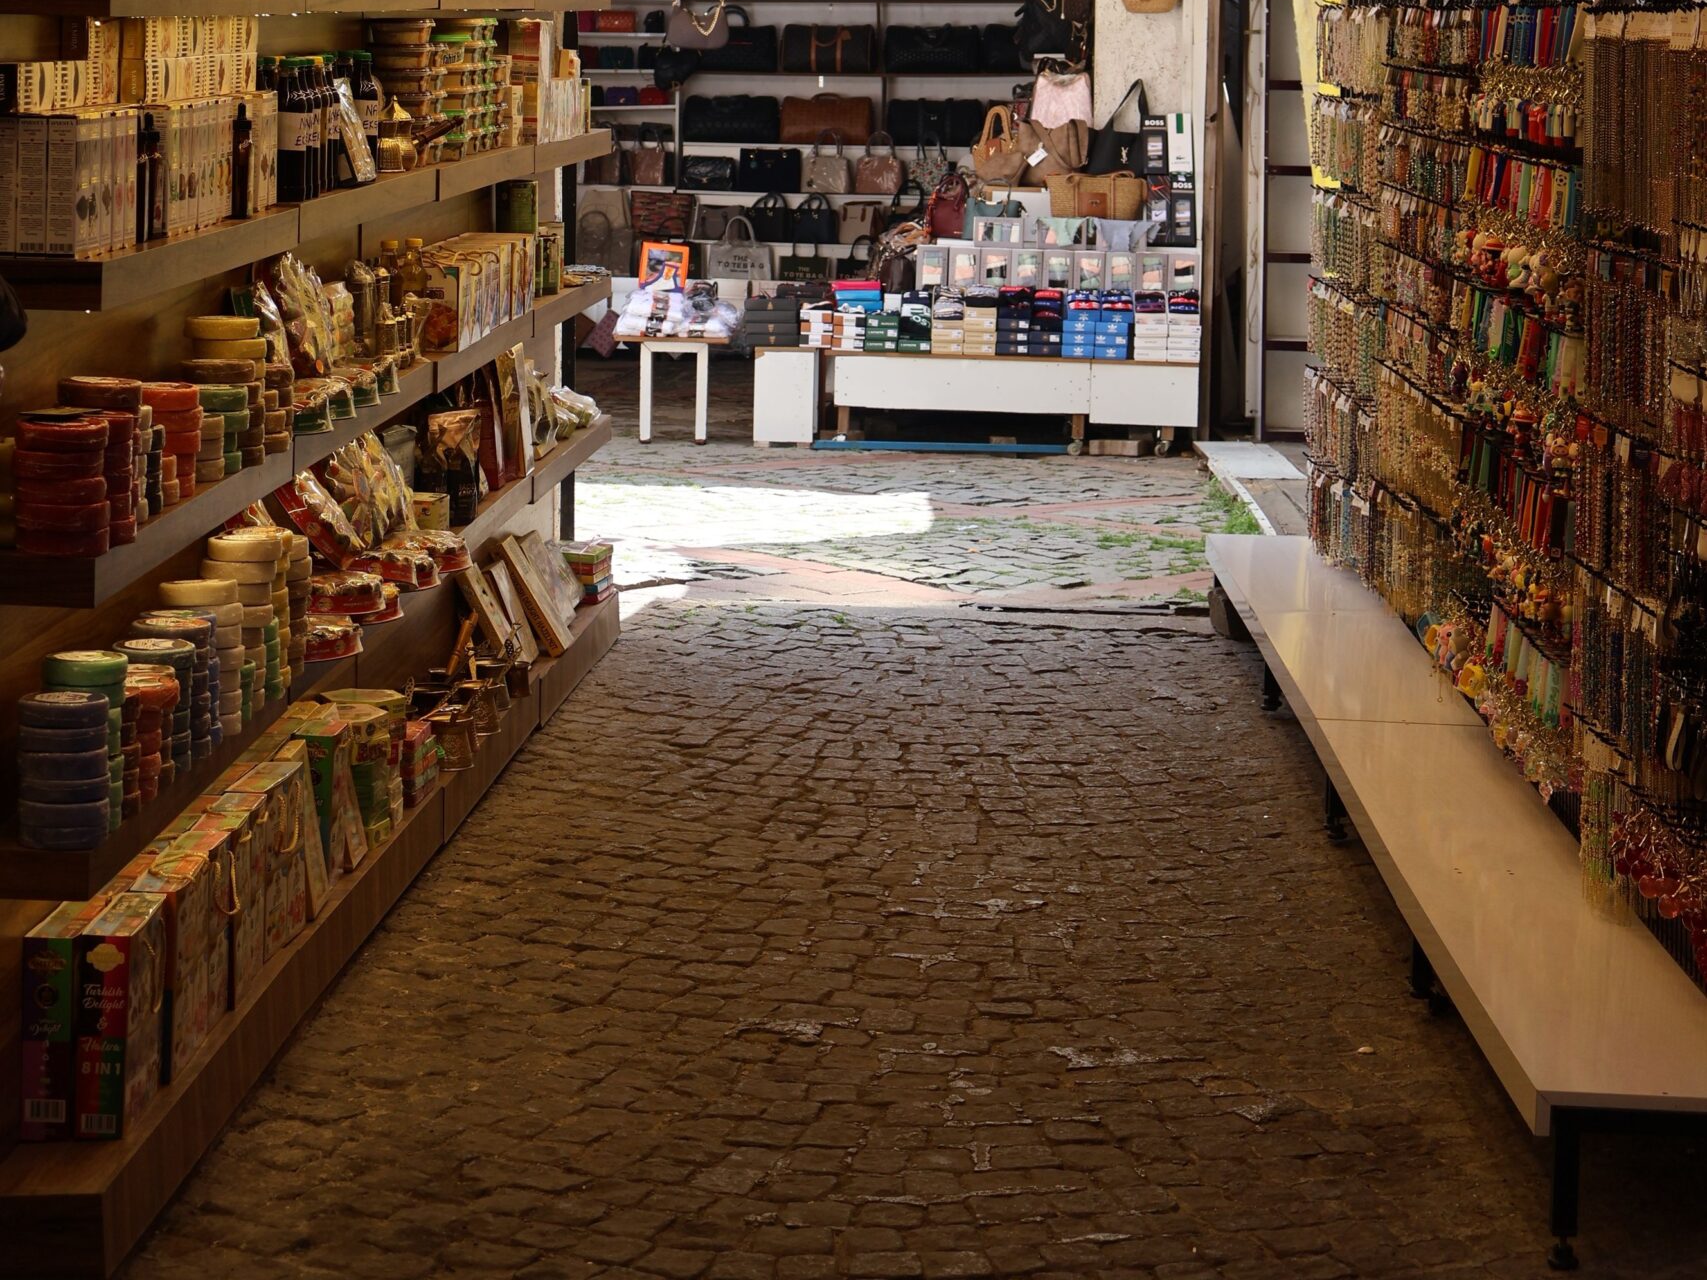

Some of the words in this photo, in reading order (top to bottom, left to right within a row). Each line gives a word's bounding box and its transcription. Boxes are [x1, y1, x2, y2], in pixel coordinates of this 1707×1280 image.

[82, 983, 124, 997] Turkish
[81, 997, 126, 1010] Delight
[96, 1017, 107, 1031] &
[81, 1062, 91, 1075] 8
[95, 1062, 112, 1075] IN
[114, 1062, 121, 1075] 1
